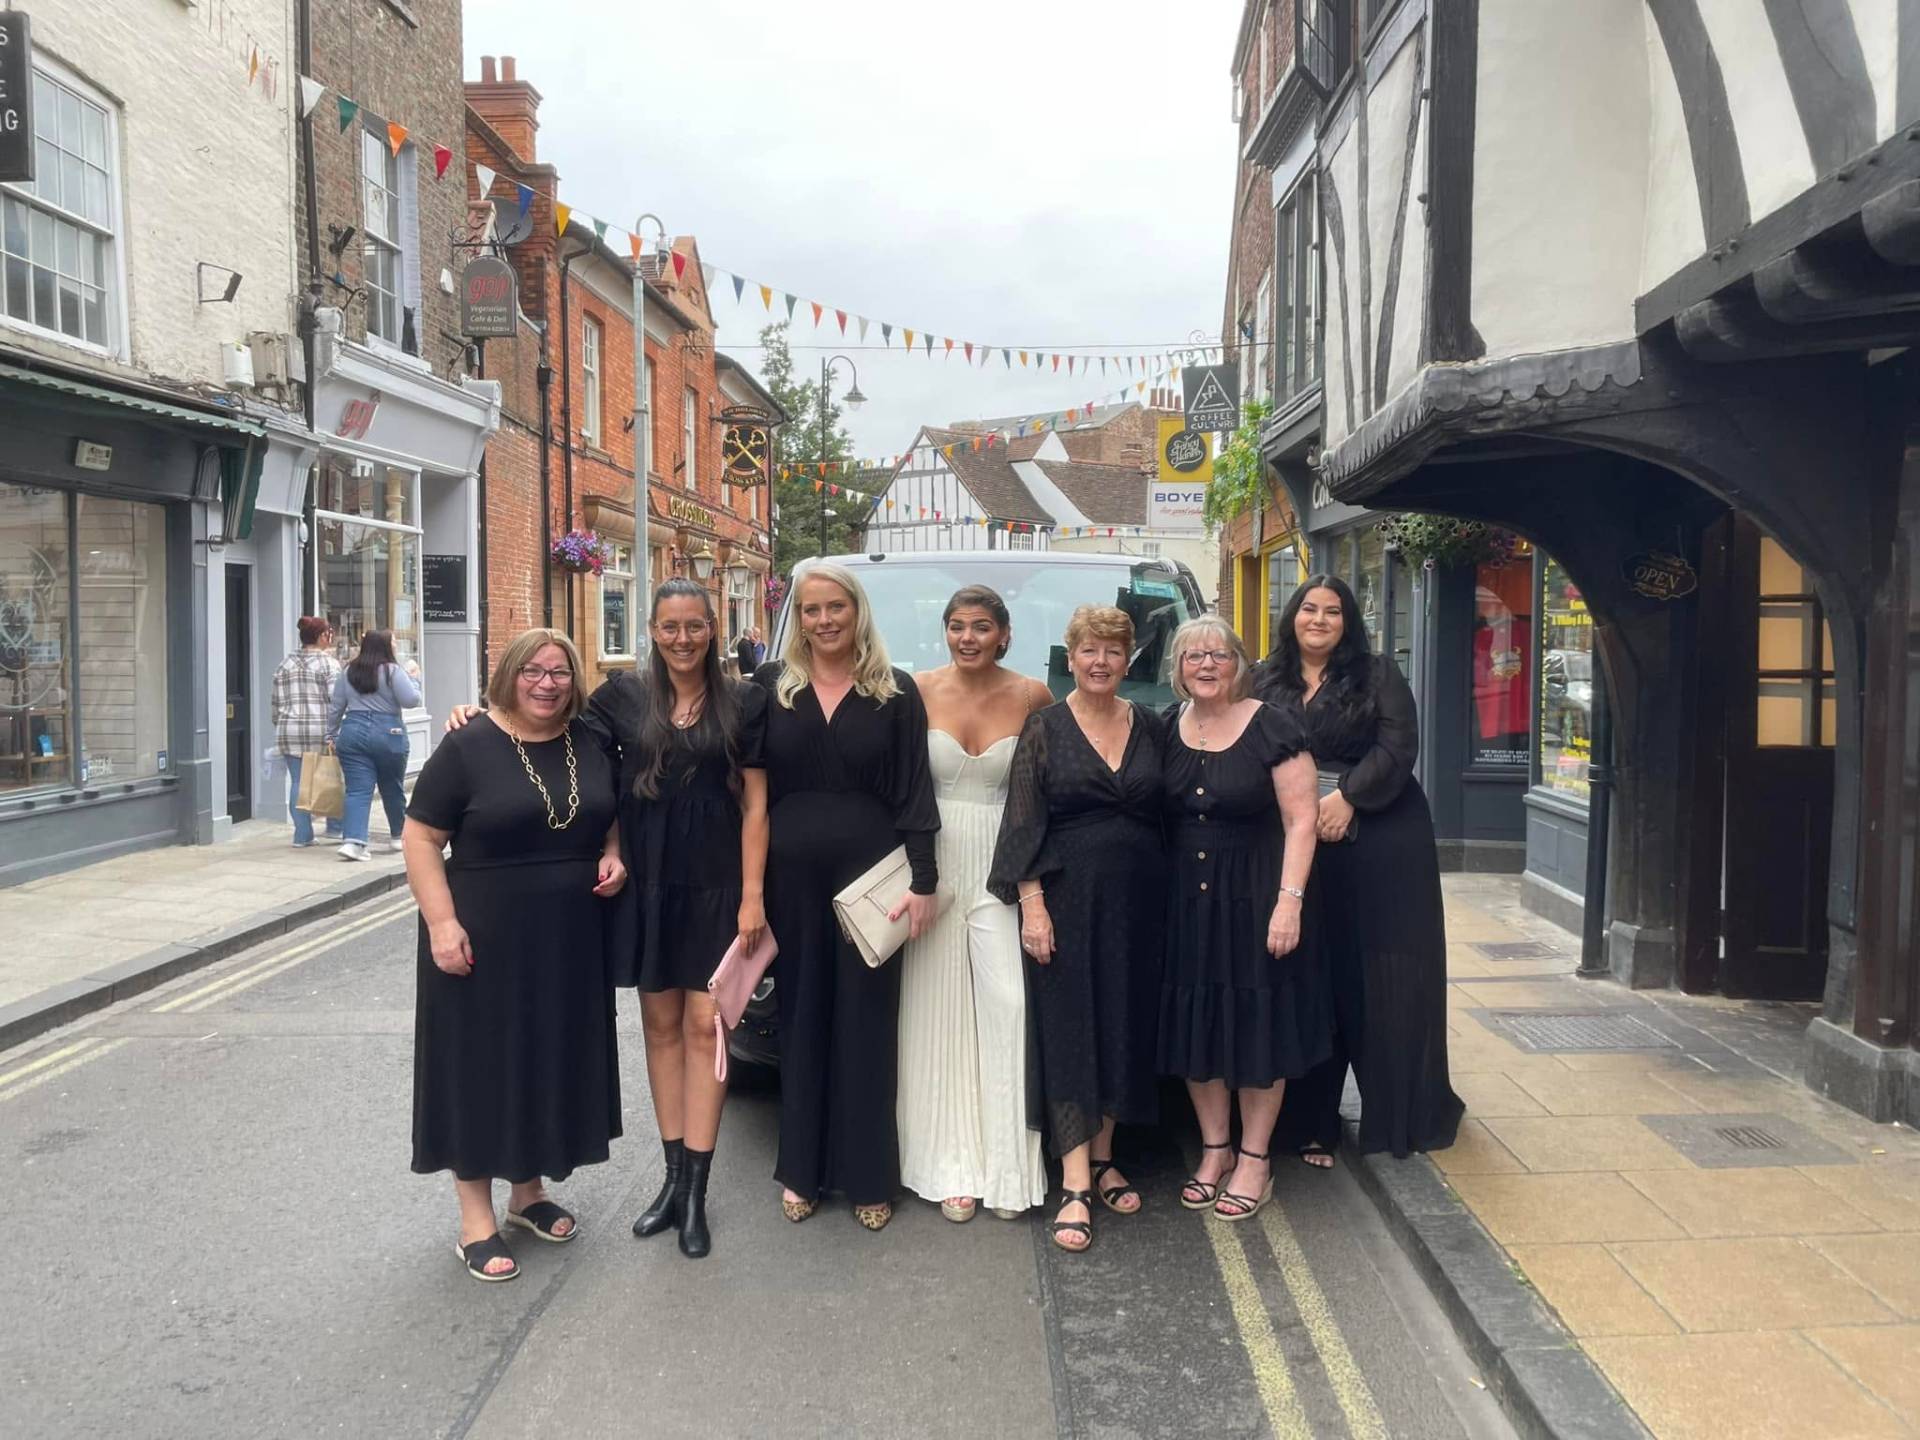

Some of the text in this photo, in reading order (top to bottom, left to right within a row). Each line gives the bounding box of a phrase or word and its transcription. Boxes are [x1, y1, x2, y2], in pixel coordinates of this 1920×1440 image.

[1193, 411, 1233, 422] COFFEE
[1190, 419, 1236, 431] CULTURE
[1155, 492, 1204, 502] BOYE
[1634, 566, 1681, 591] OPEN
